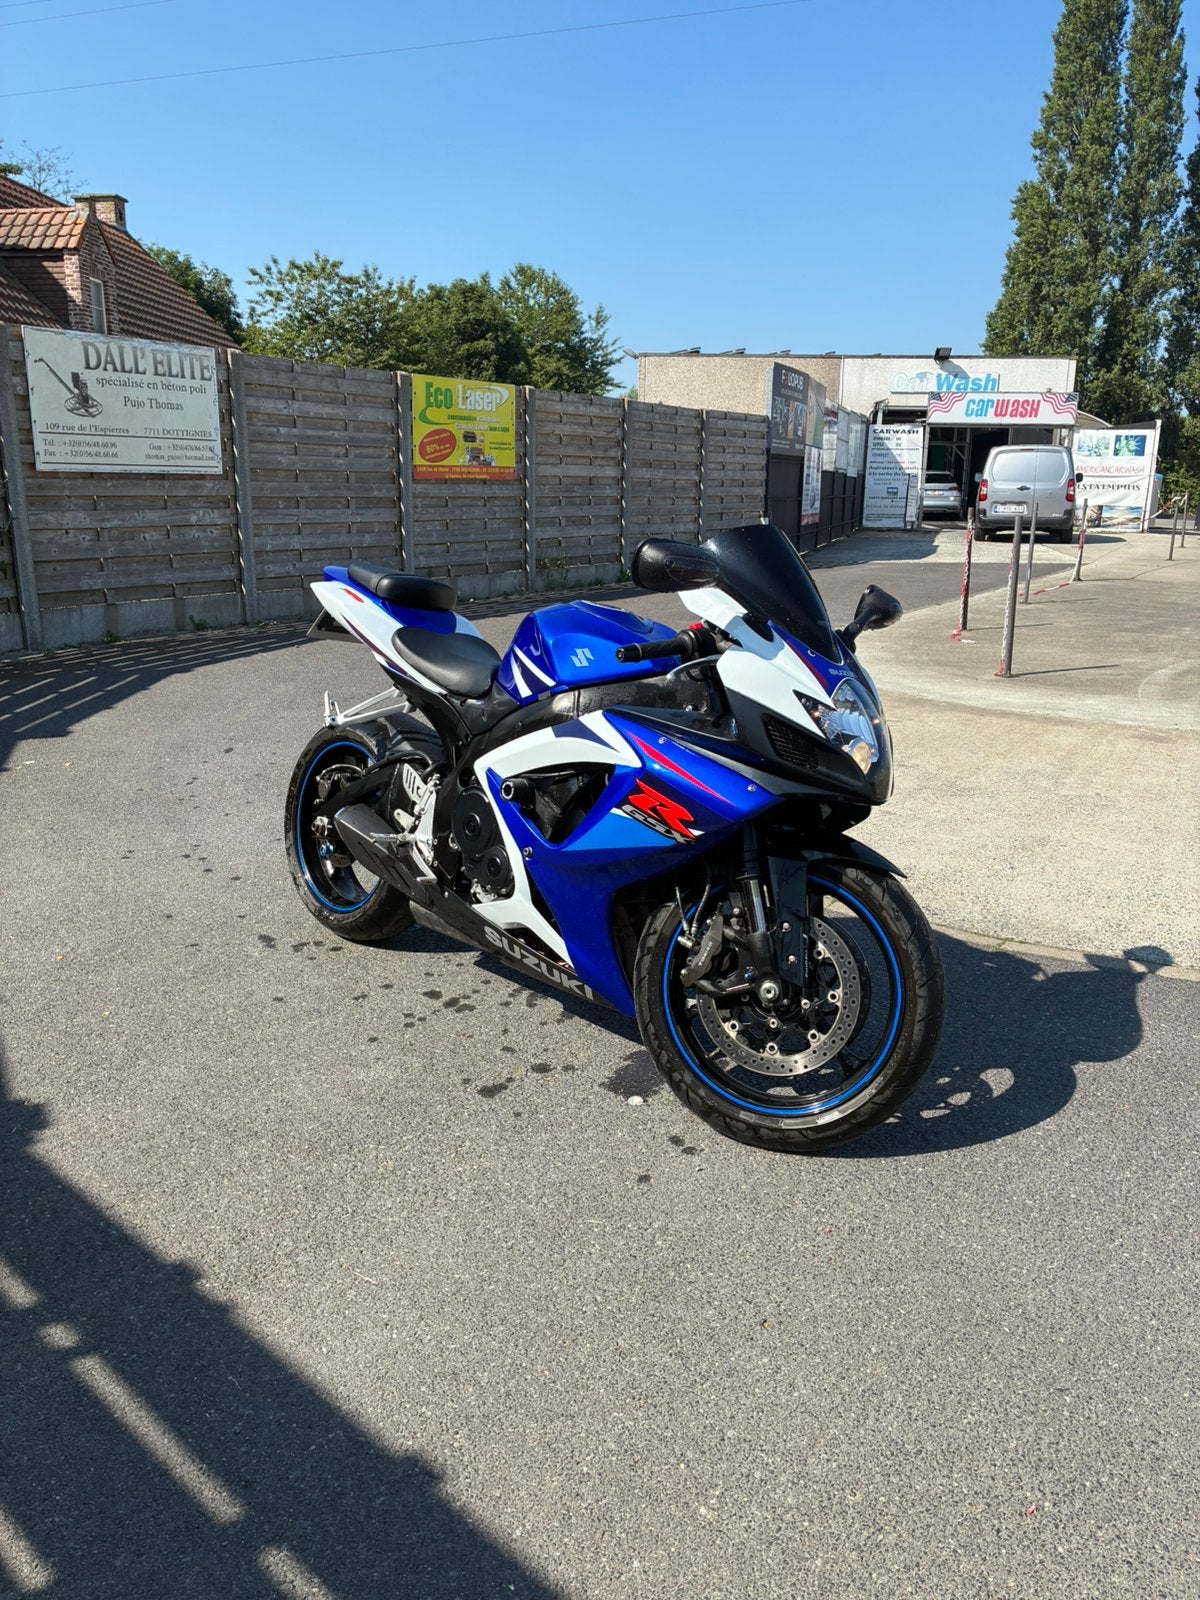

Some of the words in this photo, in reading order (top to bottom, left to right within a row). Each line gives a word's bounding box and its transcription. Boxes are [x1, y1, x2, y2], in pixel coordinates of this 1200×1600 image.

[147, 381, 158, 389] en
[161, 380, 187, 392] béton
[190, 384, 207, 395] poli
[936, 373, 997, 392] Wash
[123, 395, 145, 409] Pujo
[147, 397, 184, 411] Thomas
[424, 381, 453, 409] Eco
[457, 384, 501, 412] Laser
[45, 422, 60, 431] 109
[77, 424, 88, 432] de
[144, 427, 160, 436] 7711
[162, 428, 212, 438] DOTTIGNIES
[621, 804, 693, 845] GSX
[484, 925, 594, 1001] SUZUKI
